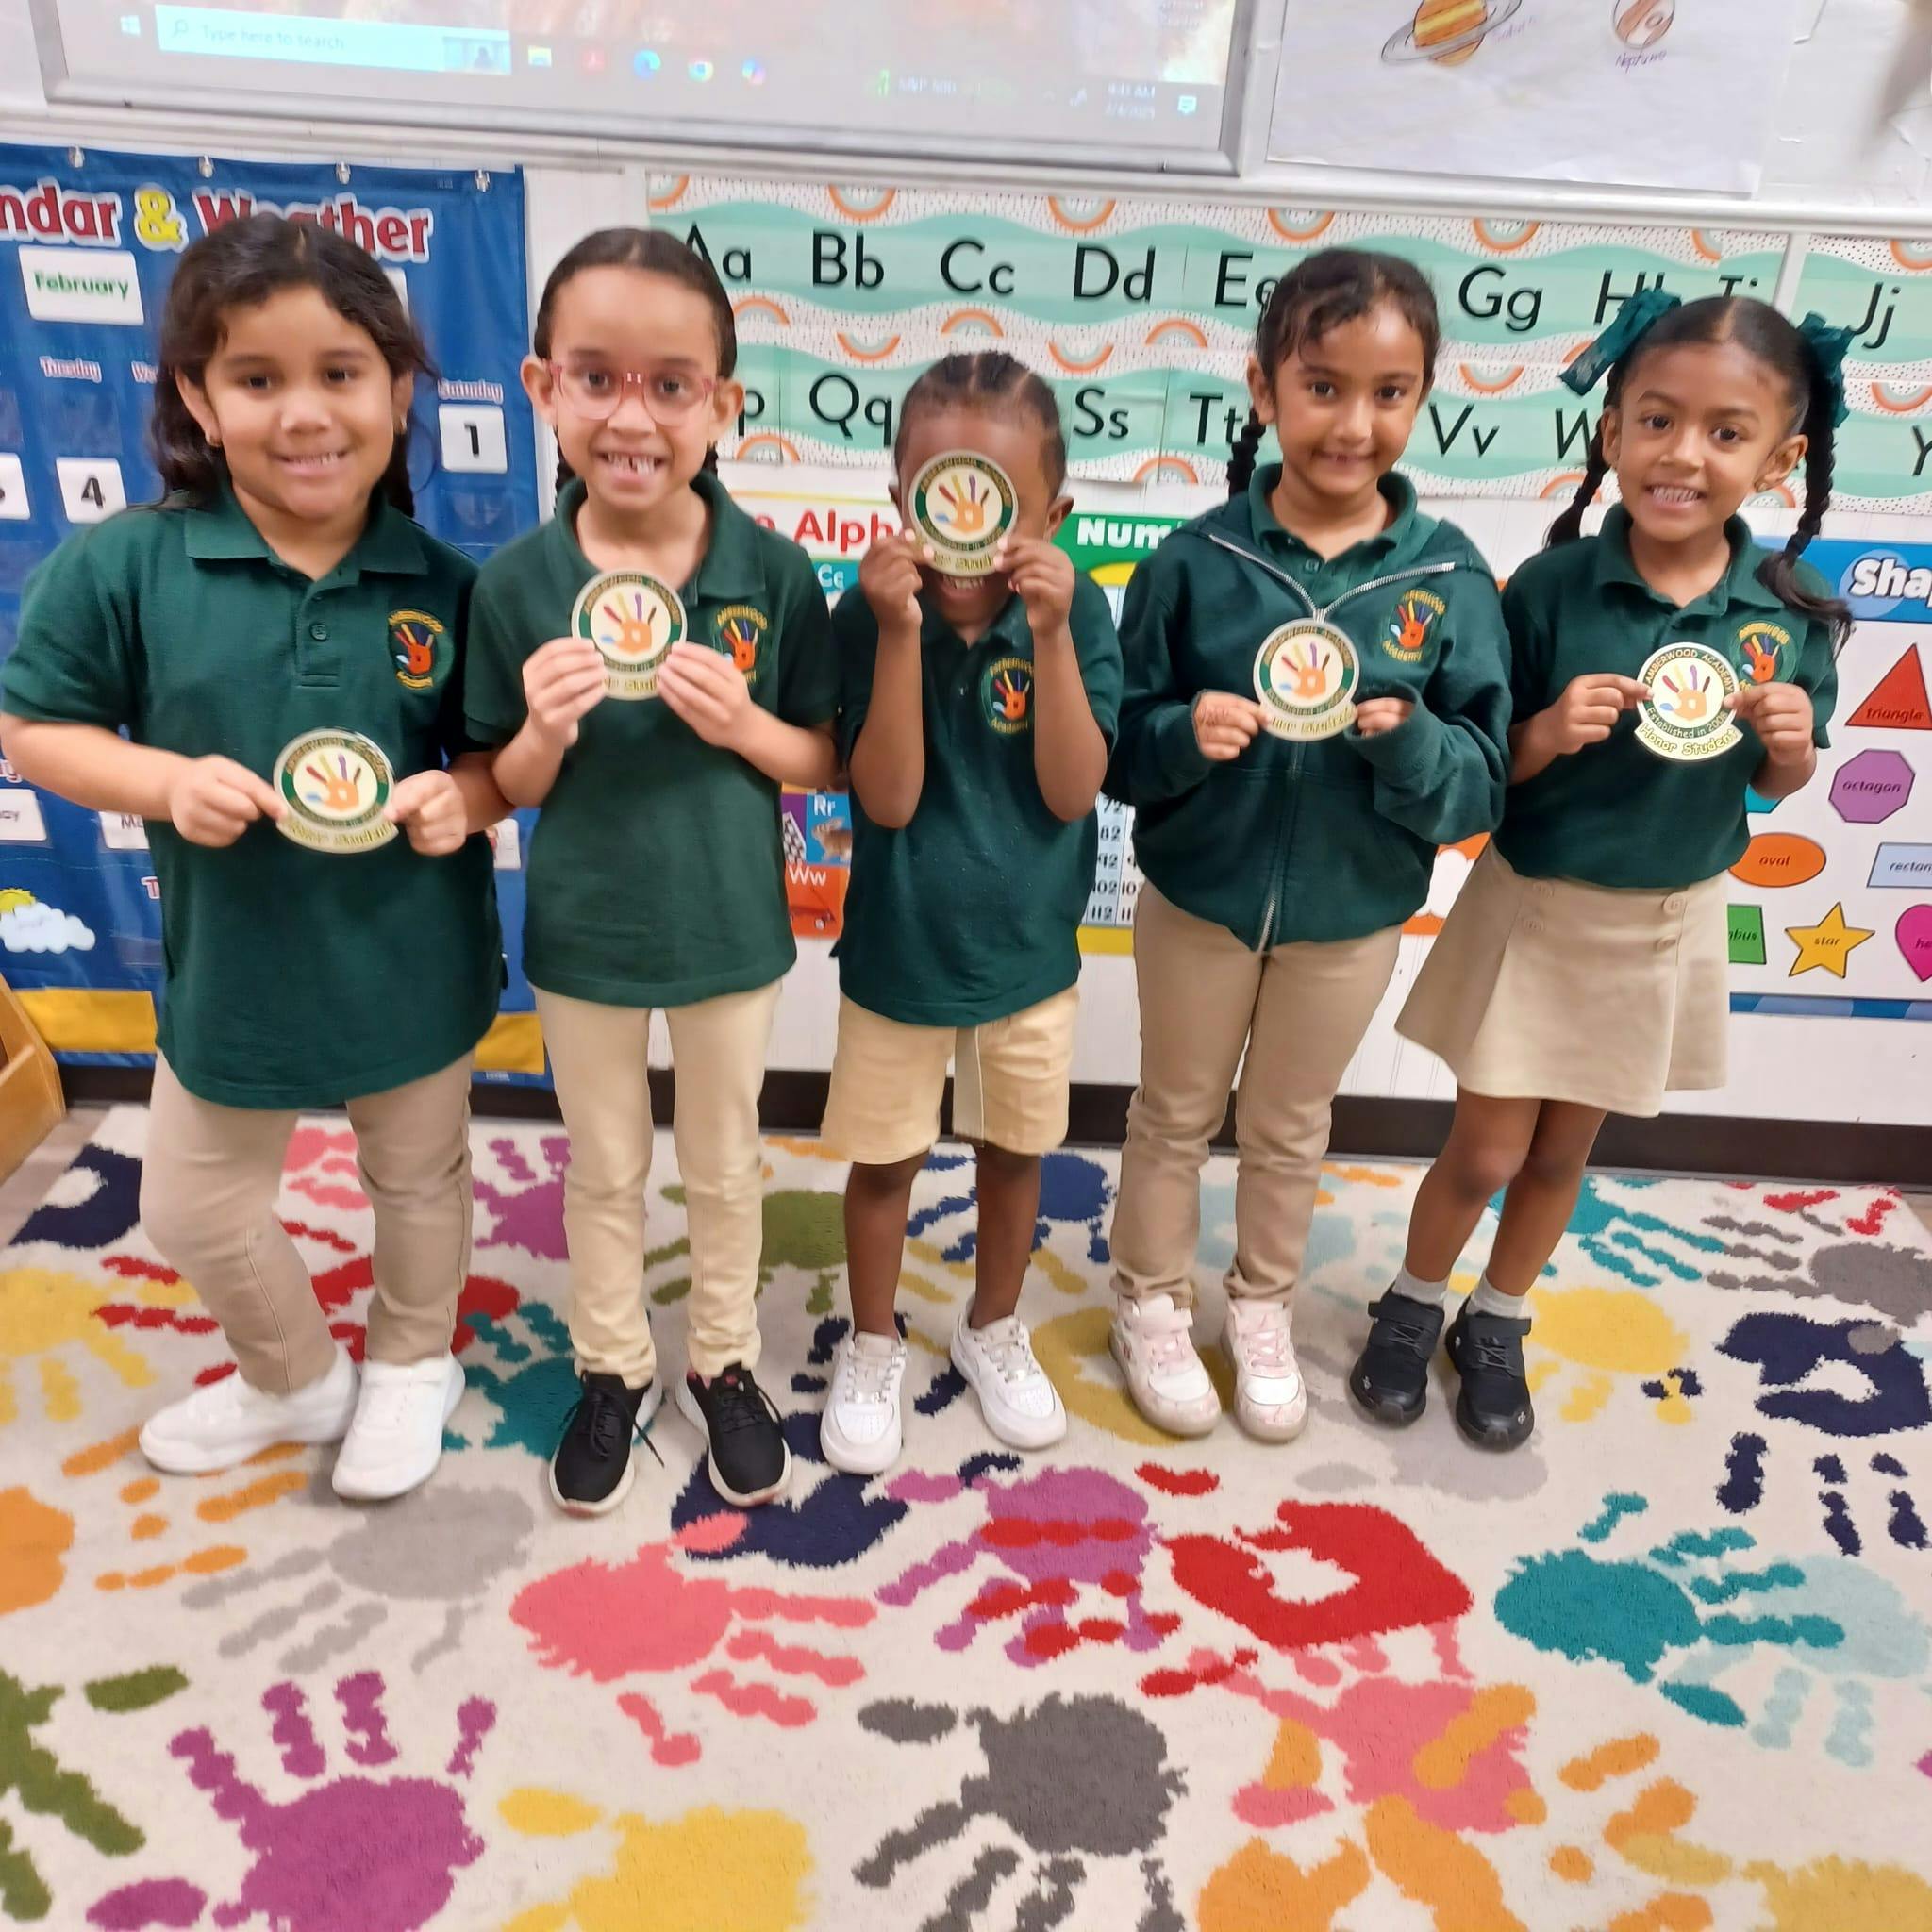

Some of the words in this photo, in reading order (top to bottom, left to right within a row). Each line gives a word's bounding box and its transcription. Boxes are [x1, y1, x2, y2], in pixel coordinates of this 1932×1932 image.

[202, 25, 235, 41] Type
[242, 26, 273, 42] here
[277, 31, 293, 45] to
[298, 33, 345, 49] search
[138, 191, 182, 243] &
[34, 271, 129, 302] February
[813, 230, 885, 290] Bb
[940, 240, 1014, 295] Cc
[1073, 242, 1156, 302] Dd
[1458, 264, 1543, 332] Gg
[1846, 282, 1901, 349] Jj
[809, 374, 892, 447] Qq
[1074, 386, 1130, 440] Ss
[1190, 391, 1243, 445] Tt
[1428, 402, 1500, 457] Vv
[464, 423, 480, 458] 1
[81, 476, 105, 509] 4
[1076, 517, 1182, 550] Num
[817, 563, 845, 592] Cc
[1644, 648, 1698, 685] AMBERWOOD
[1701, 654, 1734, 692] ACADEMY
[1647, 707, 1695, 739] Established
[1867, 708, 1924, 724] triangle
[1640, 723, 1677, 752] Honor
[1682, 727, 1738, 756] Student
[1842, 780, 1902, 794] octagon
[814, 794, 836, 817] Rr
[1098, 853, 1119, 869] 92
[1758, 855, 1791, 867] oval
[789, 866, 826, 887] Ww
[1091, 904, 1113, 921] 112
[1814, 936, 1841, 947] star
